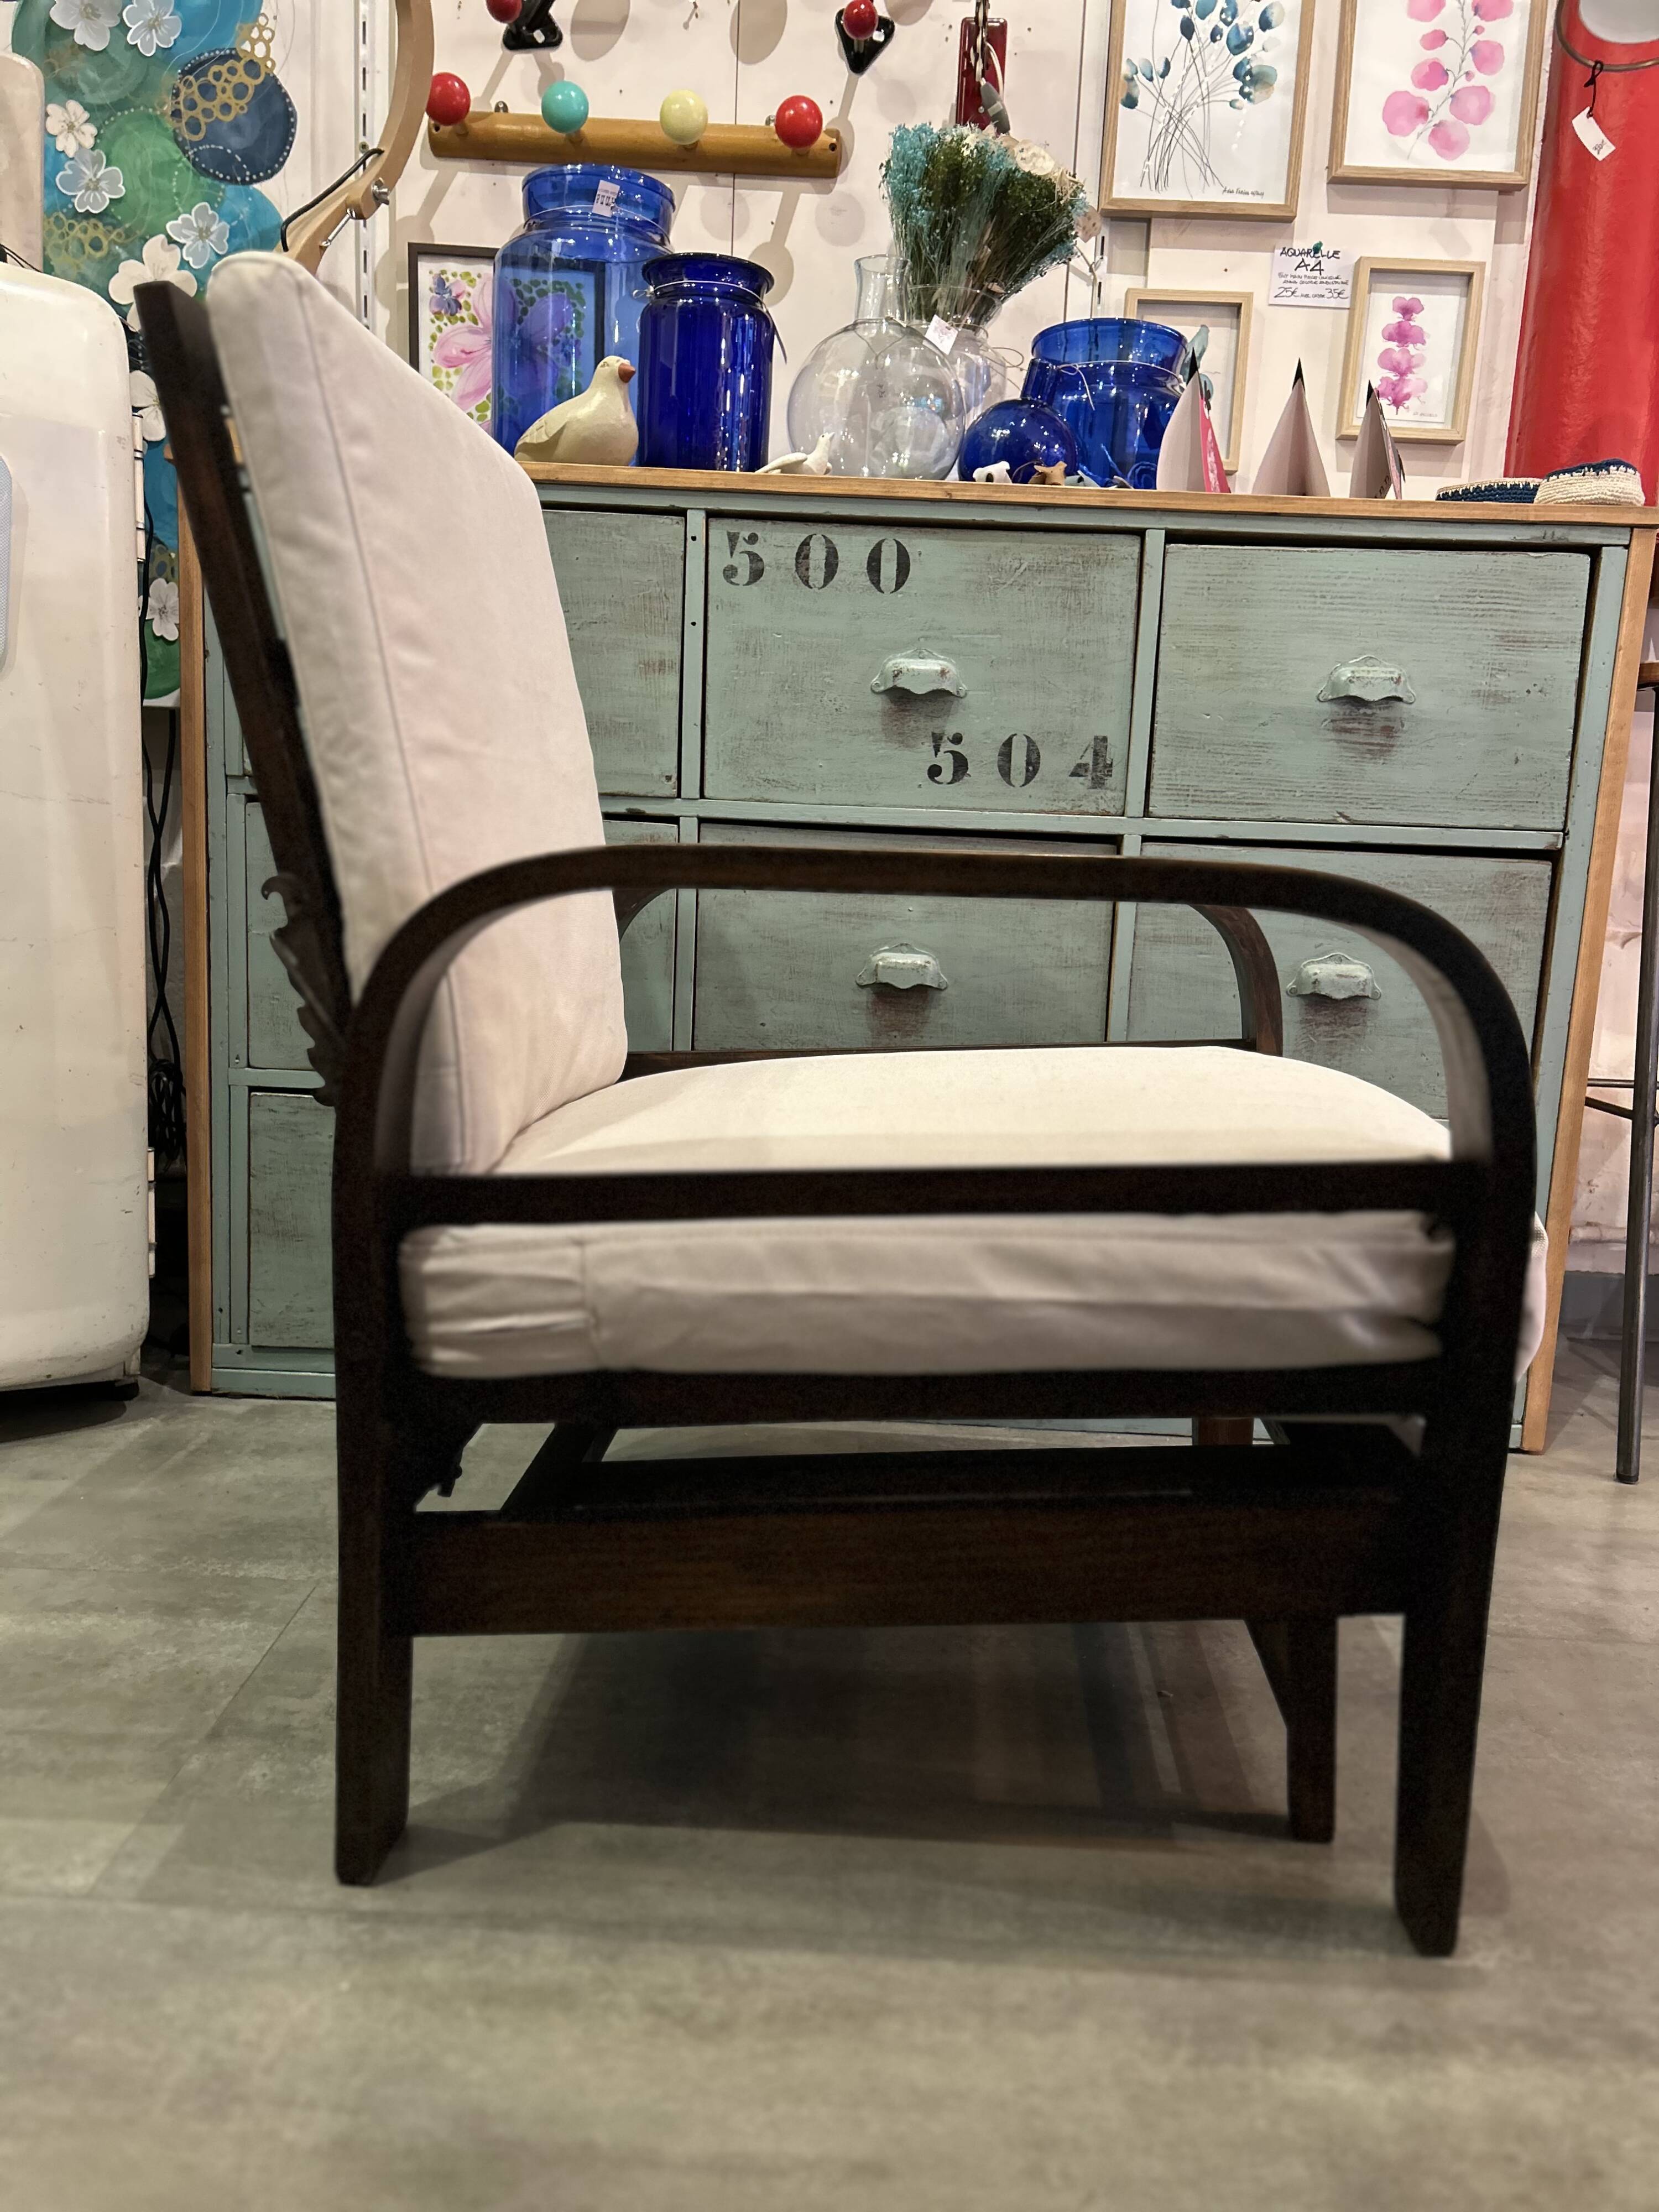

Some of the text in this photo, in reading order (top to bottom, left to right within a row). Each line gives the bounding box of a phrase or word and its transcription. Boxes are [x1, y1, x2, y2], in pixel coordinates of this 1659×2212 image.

[1280, 247, 1340, 259] AQUARELLE
[1295, 258, 1324, 275] A4
[1274, 286, 1300, 298] 25€
[1325, 288, 1349, 299] 35€
[723, 530, 910, 594] 500
[927, 732, 1113, 790] 504
